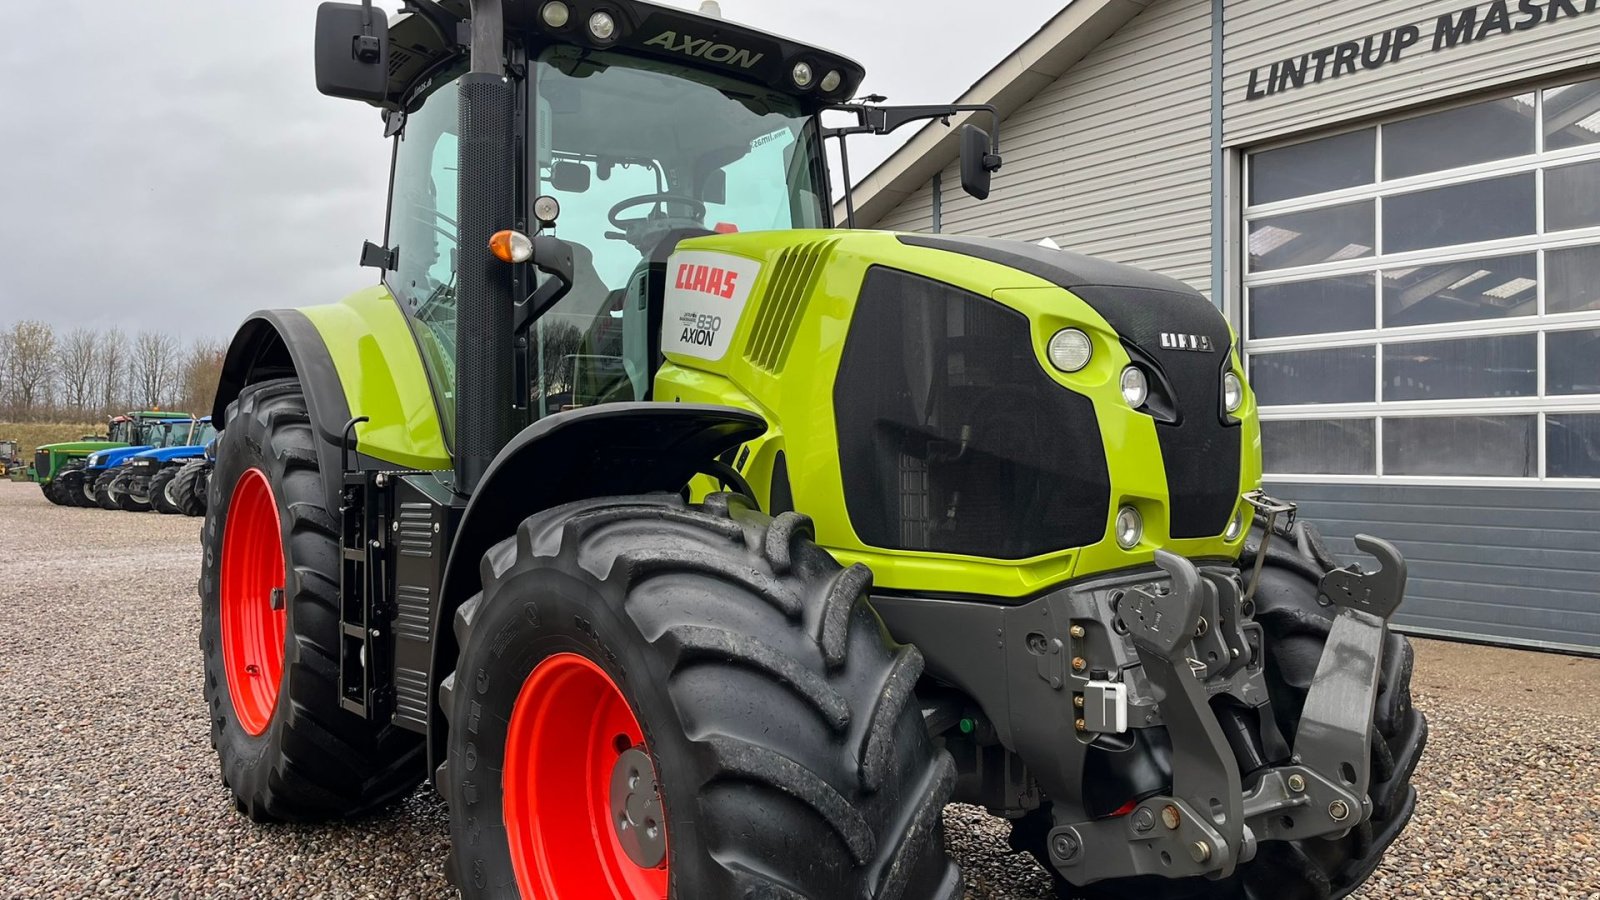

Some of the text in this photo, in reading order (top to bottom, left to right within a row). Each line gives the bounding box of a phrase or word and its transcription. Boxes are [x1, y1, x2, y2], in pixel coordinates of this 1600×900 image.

[643, 30, 764, 69] AXION
[1246, 25, 1419, 101] LINTRUP
[675, 263, 738, 299] CLAAS
[680, 327, 715, 346] AXION
[697, 314, 721, 331] 830
